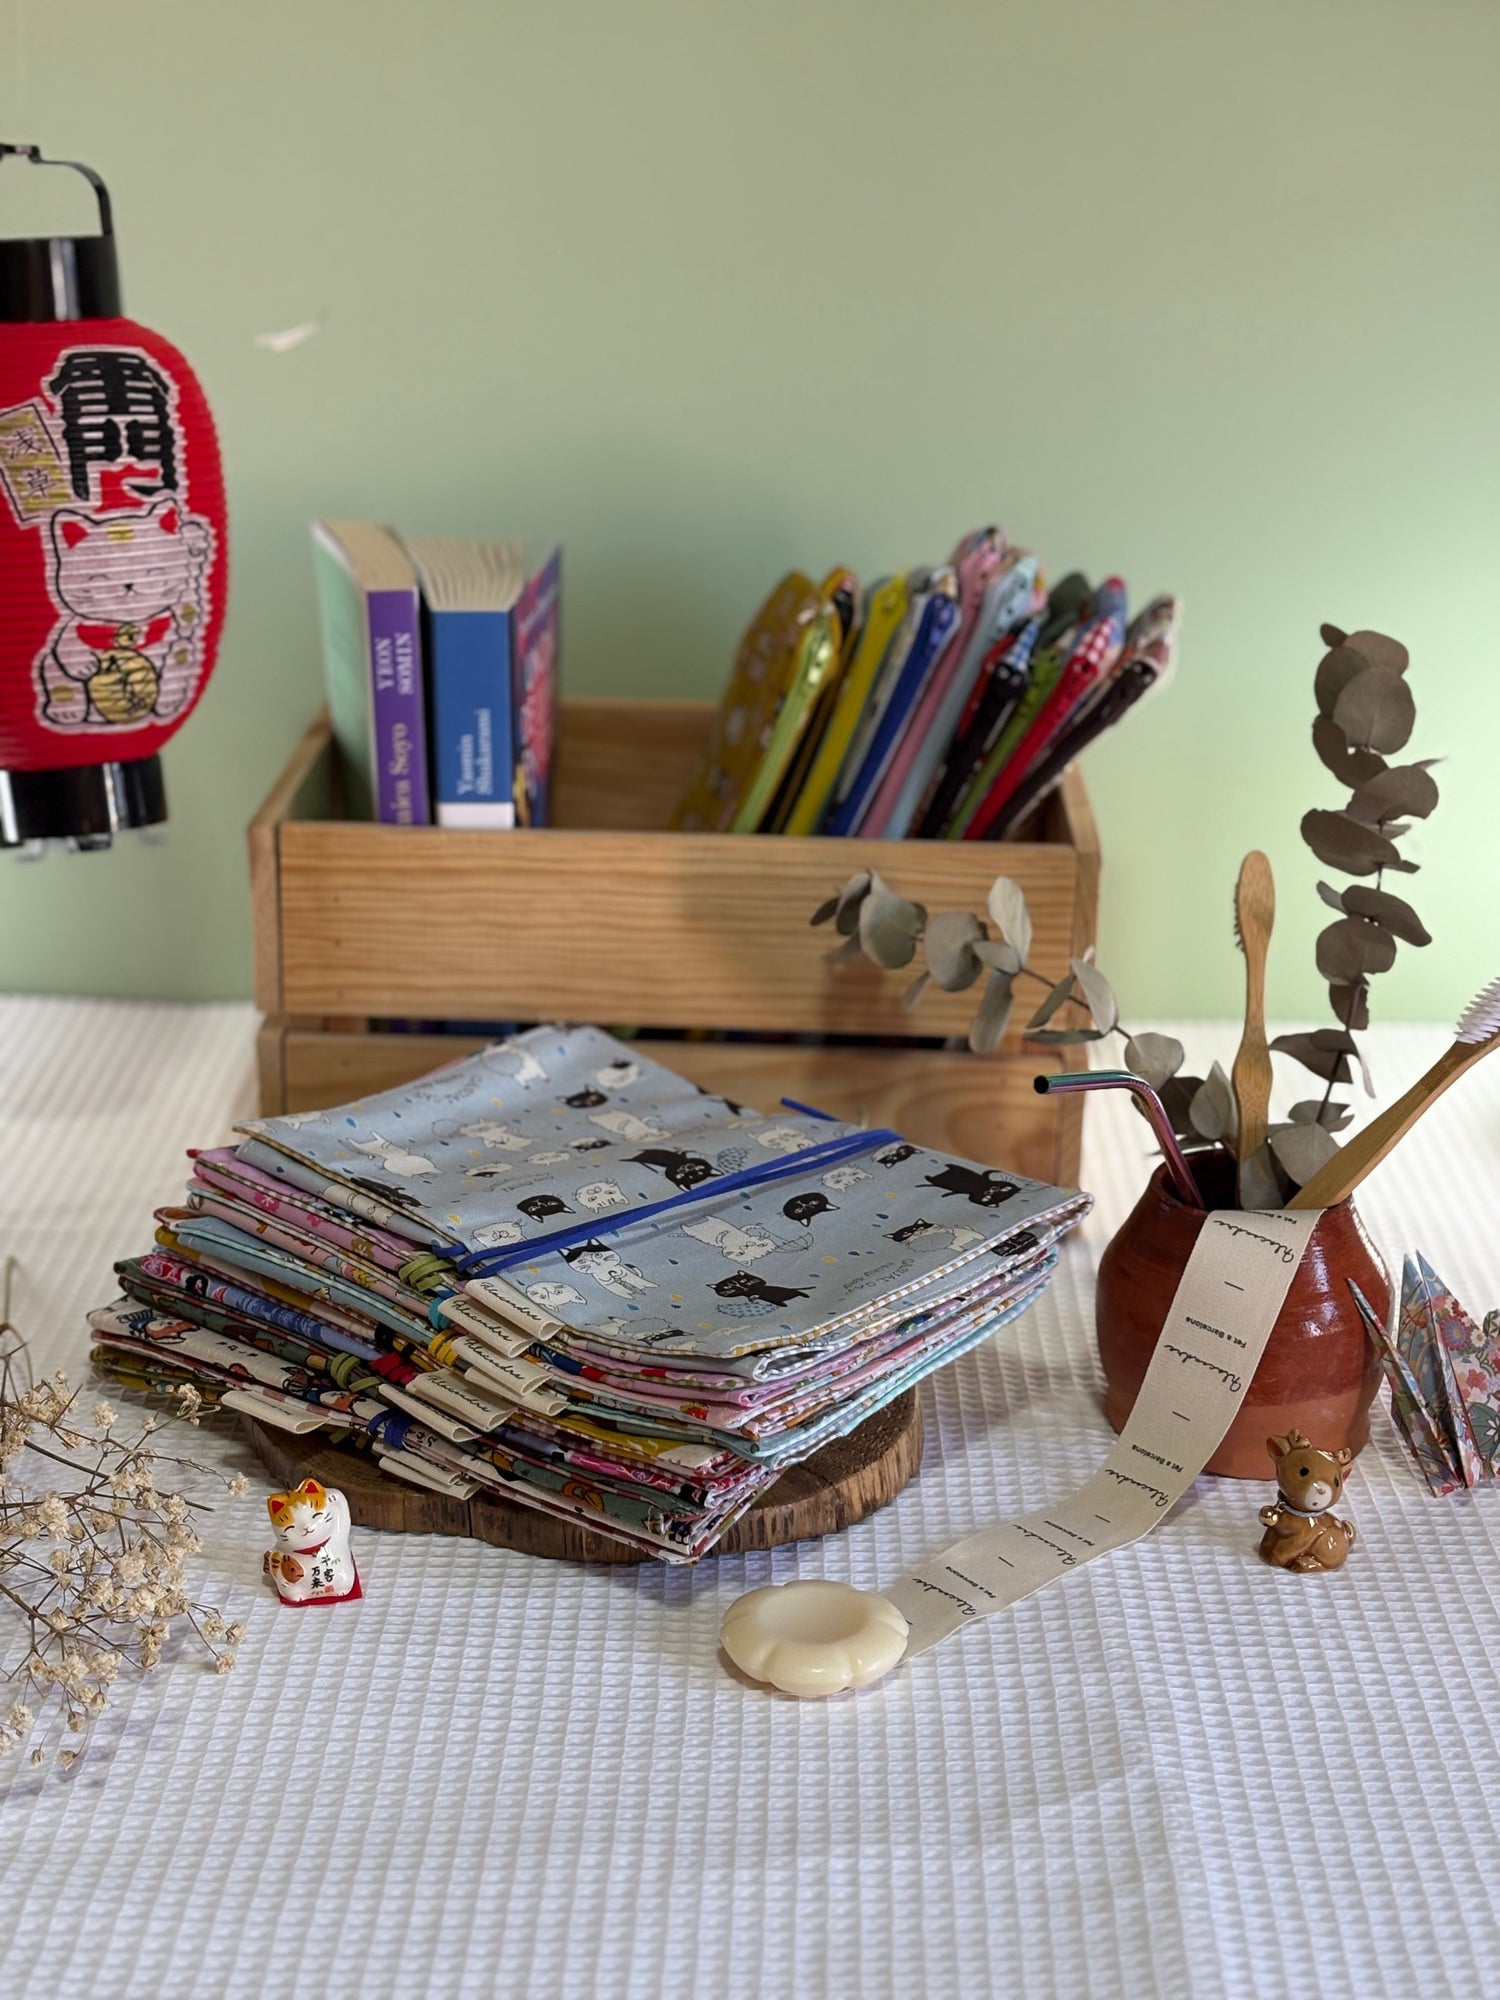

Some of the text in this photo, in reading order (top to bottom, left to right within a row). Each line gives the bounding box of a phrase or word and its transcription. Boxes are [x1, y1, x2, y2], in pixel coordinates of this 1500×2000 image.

[374, 636, 394, 691] YEON
[394, 633, 415, 695] SOMIN
[1185, 1316, 1226, 1339] Barcelona
[1233, 1337, 1247, 1349] Fet
[1131, 1444, 1166, 1465] Barcelona
[1171, 1463, 1184, 1473] Fet
